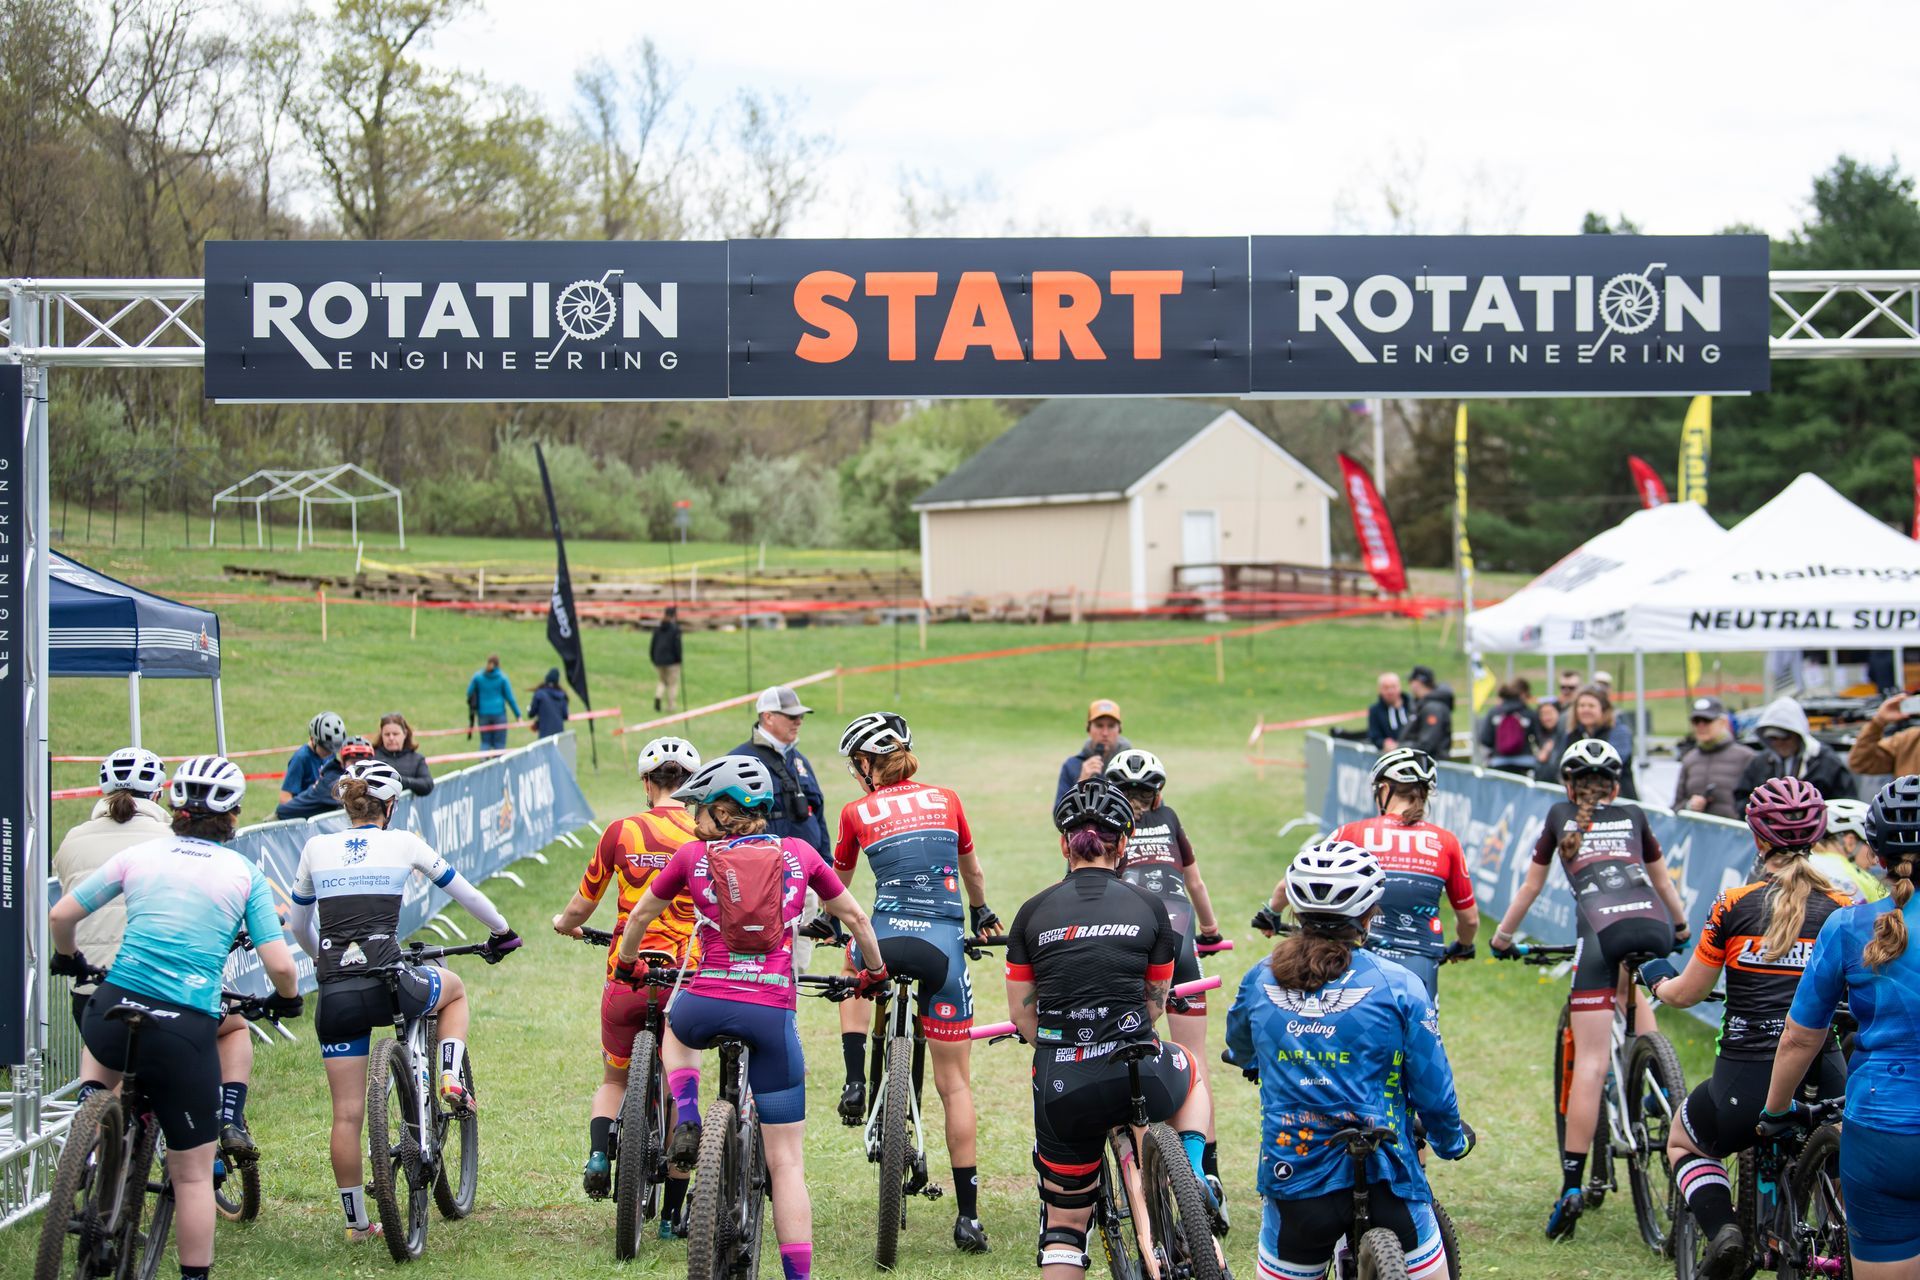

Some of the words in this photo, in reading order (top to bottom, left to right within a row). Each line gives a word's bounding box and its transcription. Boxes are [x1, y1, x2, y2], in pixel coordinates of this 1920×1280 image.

[794, 270, 1184, 364] START
[1298, 274, 1721, 363] ROTATION
[253, 281, 678, 369] ROTATION
[338, 350, 679, 370] ENGINEERING
[1384, 343, 1722, 364] ENGINEERING
[1690, 609, 1840, 631] NEUTRAL
[1853, 608, 1920, 630] SUP
[877, 784, 920, 796] BOSTON
[857, 788, 948, 825] UTC
[873, 814, 949, 833] BUTCHERBOX
[1134, 823, 1171, 837] RACING
[1592, 819, 1634, 831] RACING
[1140, 844, 1170, 852] KATE'S
[1363, 827, 1440, 858] UTC
[1593, 839, 1627, 847] KATE'S
[181, 850, 213, 859] vittoria
[1379, 855, 1438, 868] UTCHERBOX
[3, 818, 13, 909] CHAMPIONSHIP
[783, 850, 805, 879] cing
[322, 877, 347, 888] ncc
[727, 868, 742, 904] CAMELBAK
[1598, 901, 1653, 915] TREK
[888, 917, 932, 929] PANDA
[1039, 927, 1069, 940] COMP
[1075, 924, 1140, 938] RACING
[1038, 932, 1066, 946] EDGE
[941, 1005, 951, 1016] B
[1286, 1019, 1337, 1039] Cycling
[1055, 1054, 1077, 1062] EDGE
[1056, 1047, 1078, 1055] COMP
[1277, 1050, 1351, 1064] AIRLINE
